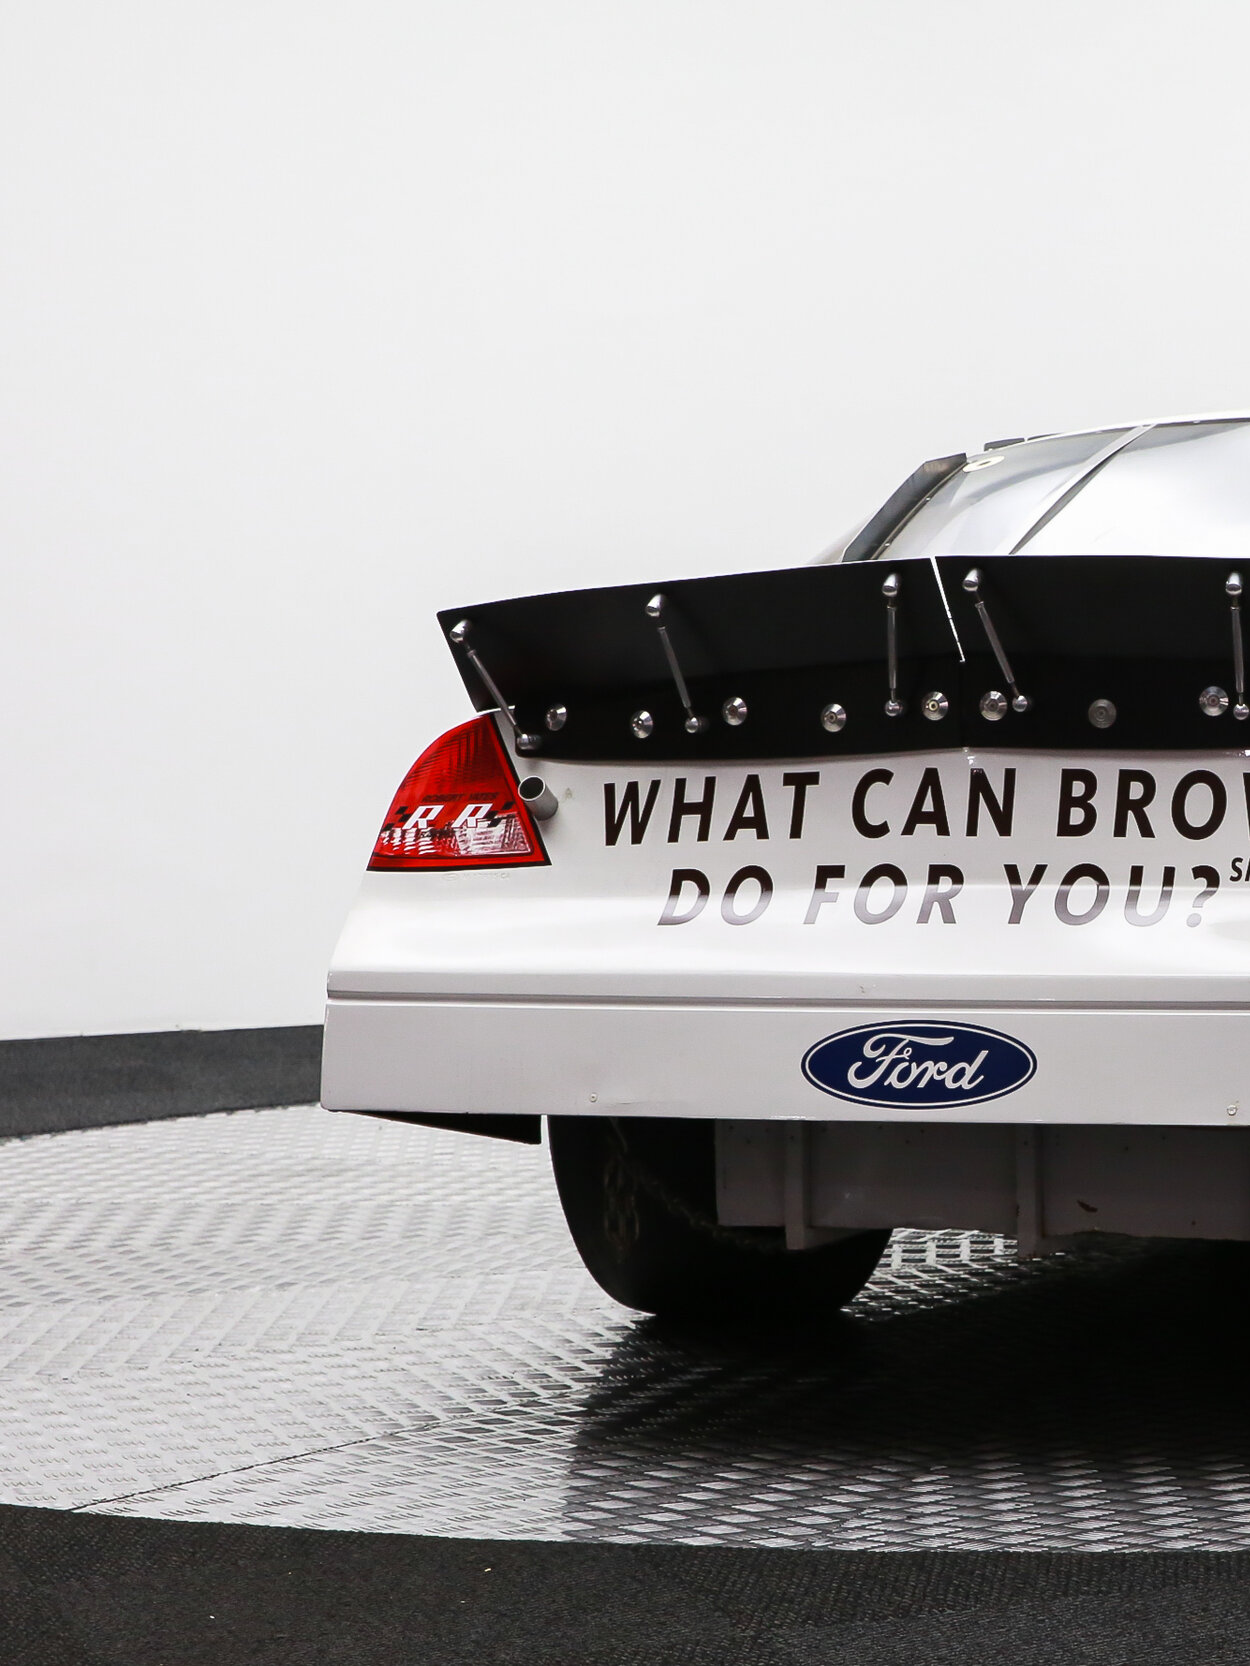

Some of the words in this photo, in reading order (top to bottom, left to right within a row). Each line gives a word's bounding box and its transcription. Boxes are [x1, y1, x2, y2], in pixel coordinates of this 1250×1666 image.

[603, 771, 820, 847] WHAT
[851, 767, 1016, 839] CAN
[657, 864, 774, 926] DO
[803, 863, 965, 926] FOR
[1003, 863, 1220, 928] YOU?
[847, 1033, 989, 1090] Ford
